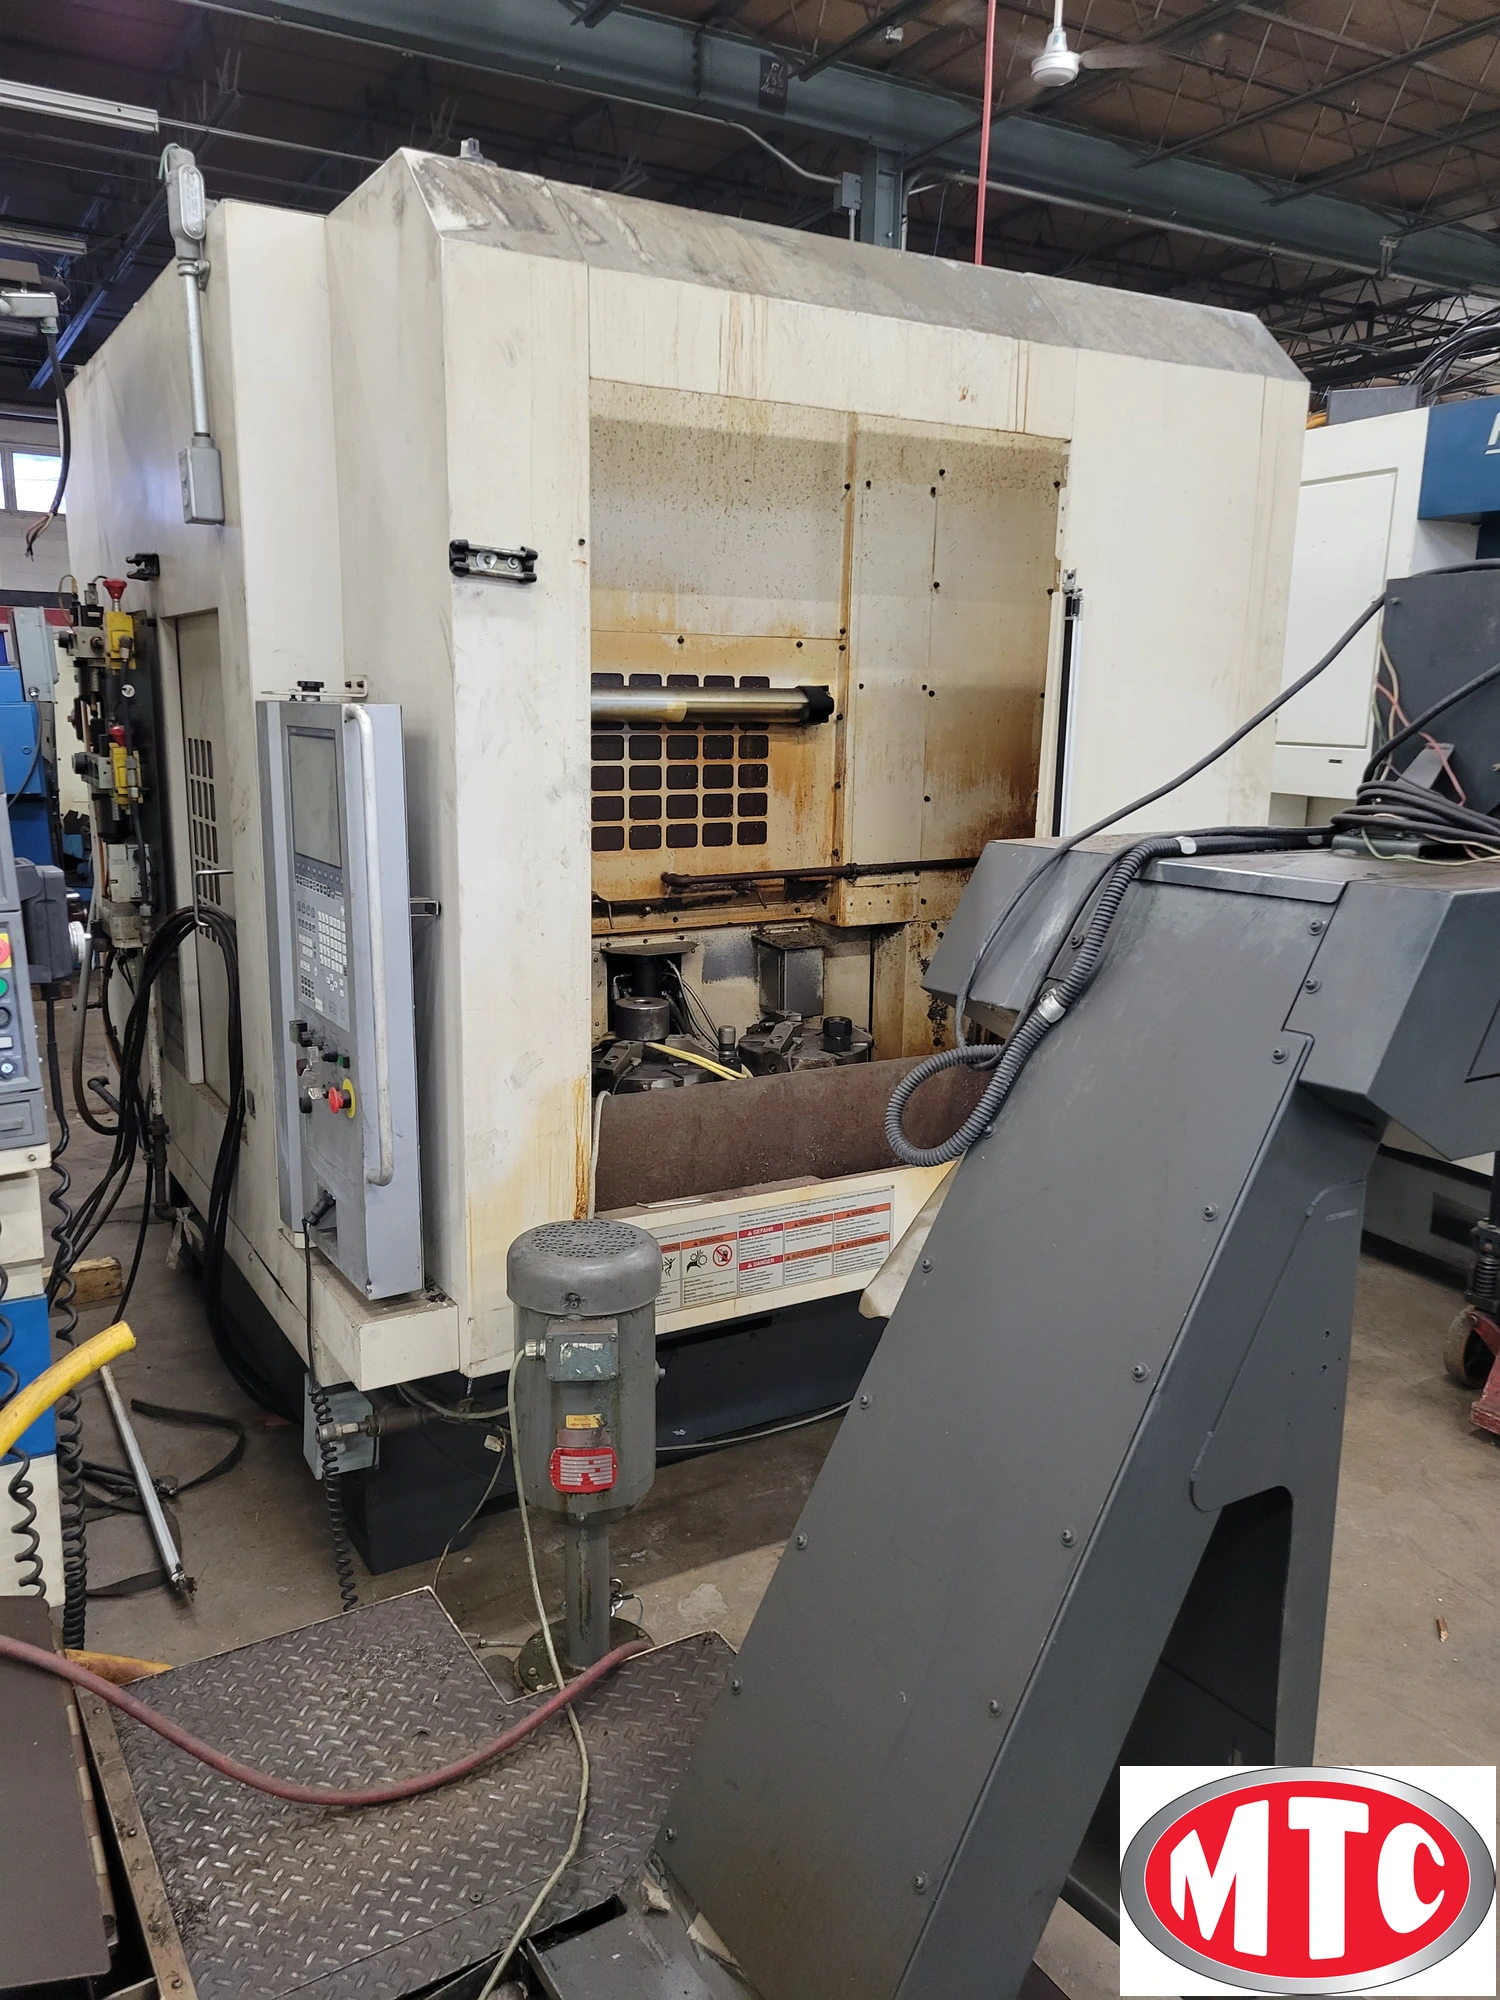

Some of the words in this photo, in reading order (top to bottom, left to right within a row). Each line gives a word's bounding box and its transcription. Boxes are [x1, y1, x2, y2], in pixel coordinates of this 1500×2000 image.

[752, 1226, 774, 1235] GEFAHR
[699, 1235, 724, 1245] WARNING
[753, 1258, 775, 1267] DANGER
